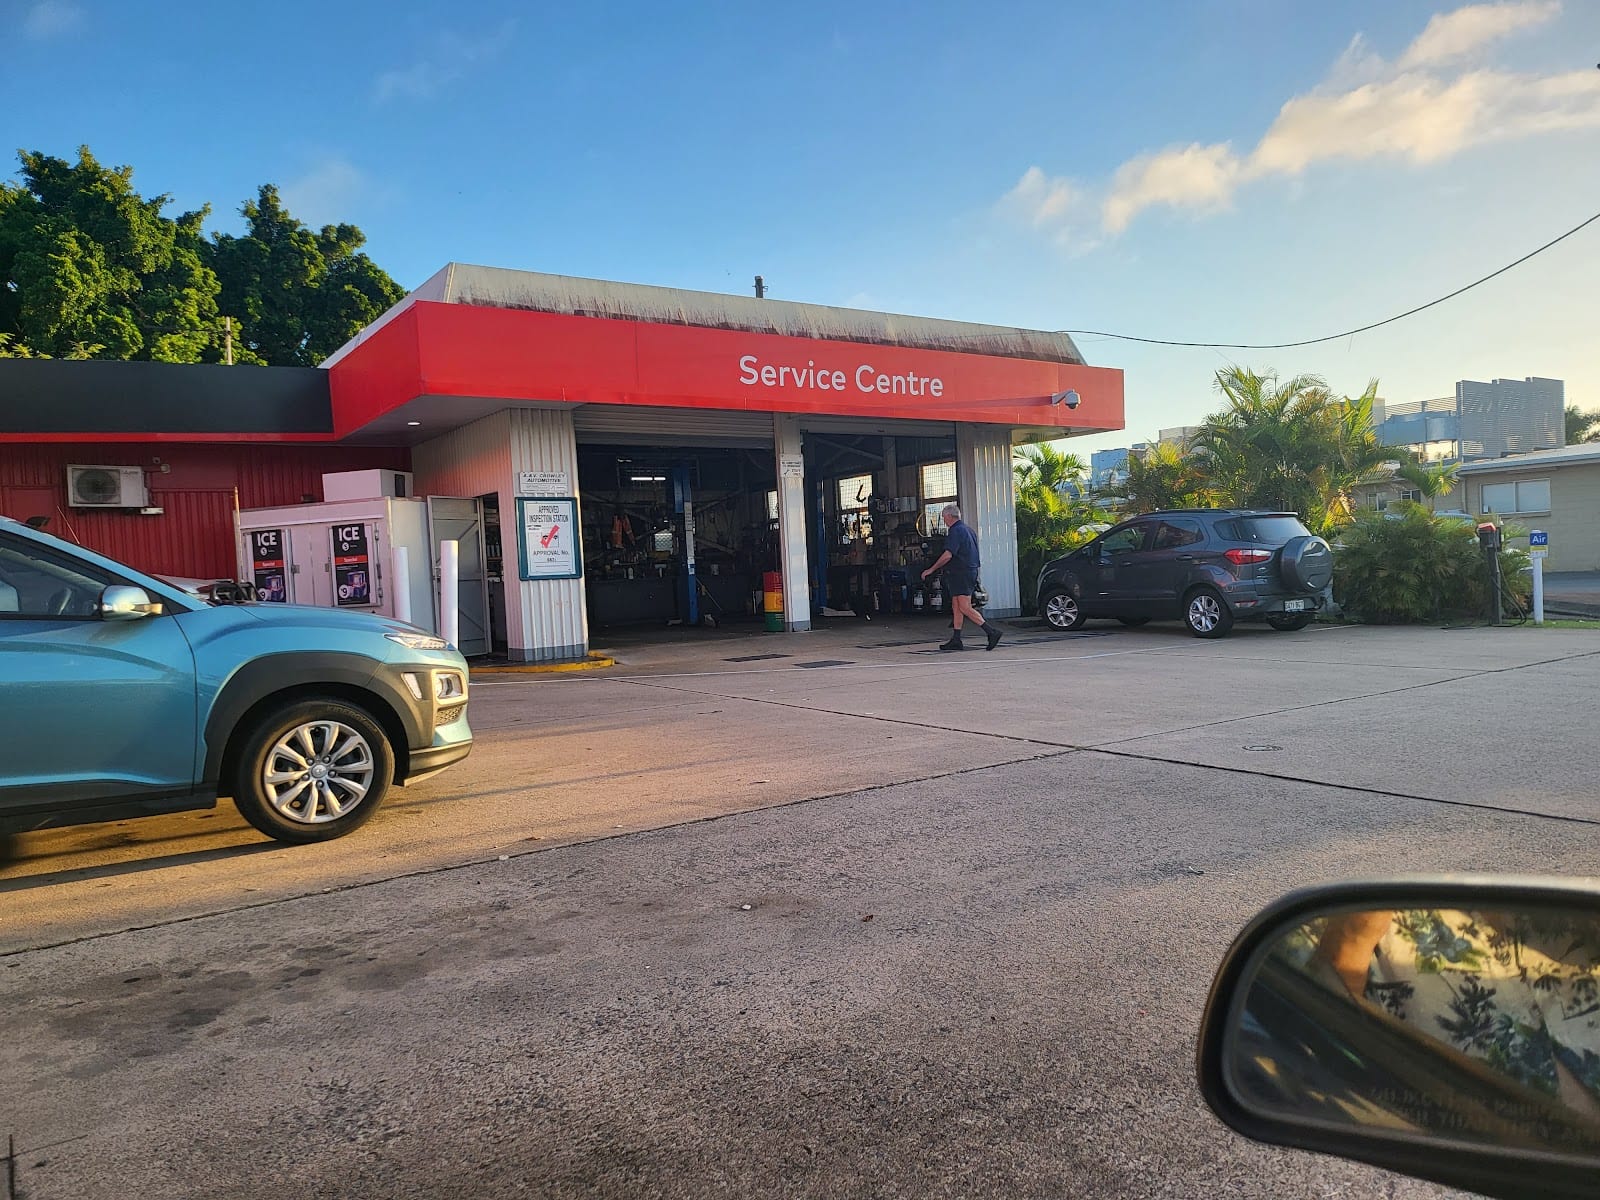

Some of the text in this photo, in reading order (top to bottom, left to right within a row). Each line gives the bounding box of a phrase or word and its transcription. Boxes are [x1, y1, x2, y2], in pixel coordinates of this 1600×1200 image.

[739, 355, 944, 397] Service Centre
[538, 505, 559, 513] APPROVED
[529, 514, 569, 523] INSPECTION STATION
[257, 532, 277, 547] ICE
[338, 526, 360, 541] ICE
[1532, 535, 1546, 543] Air
